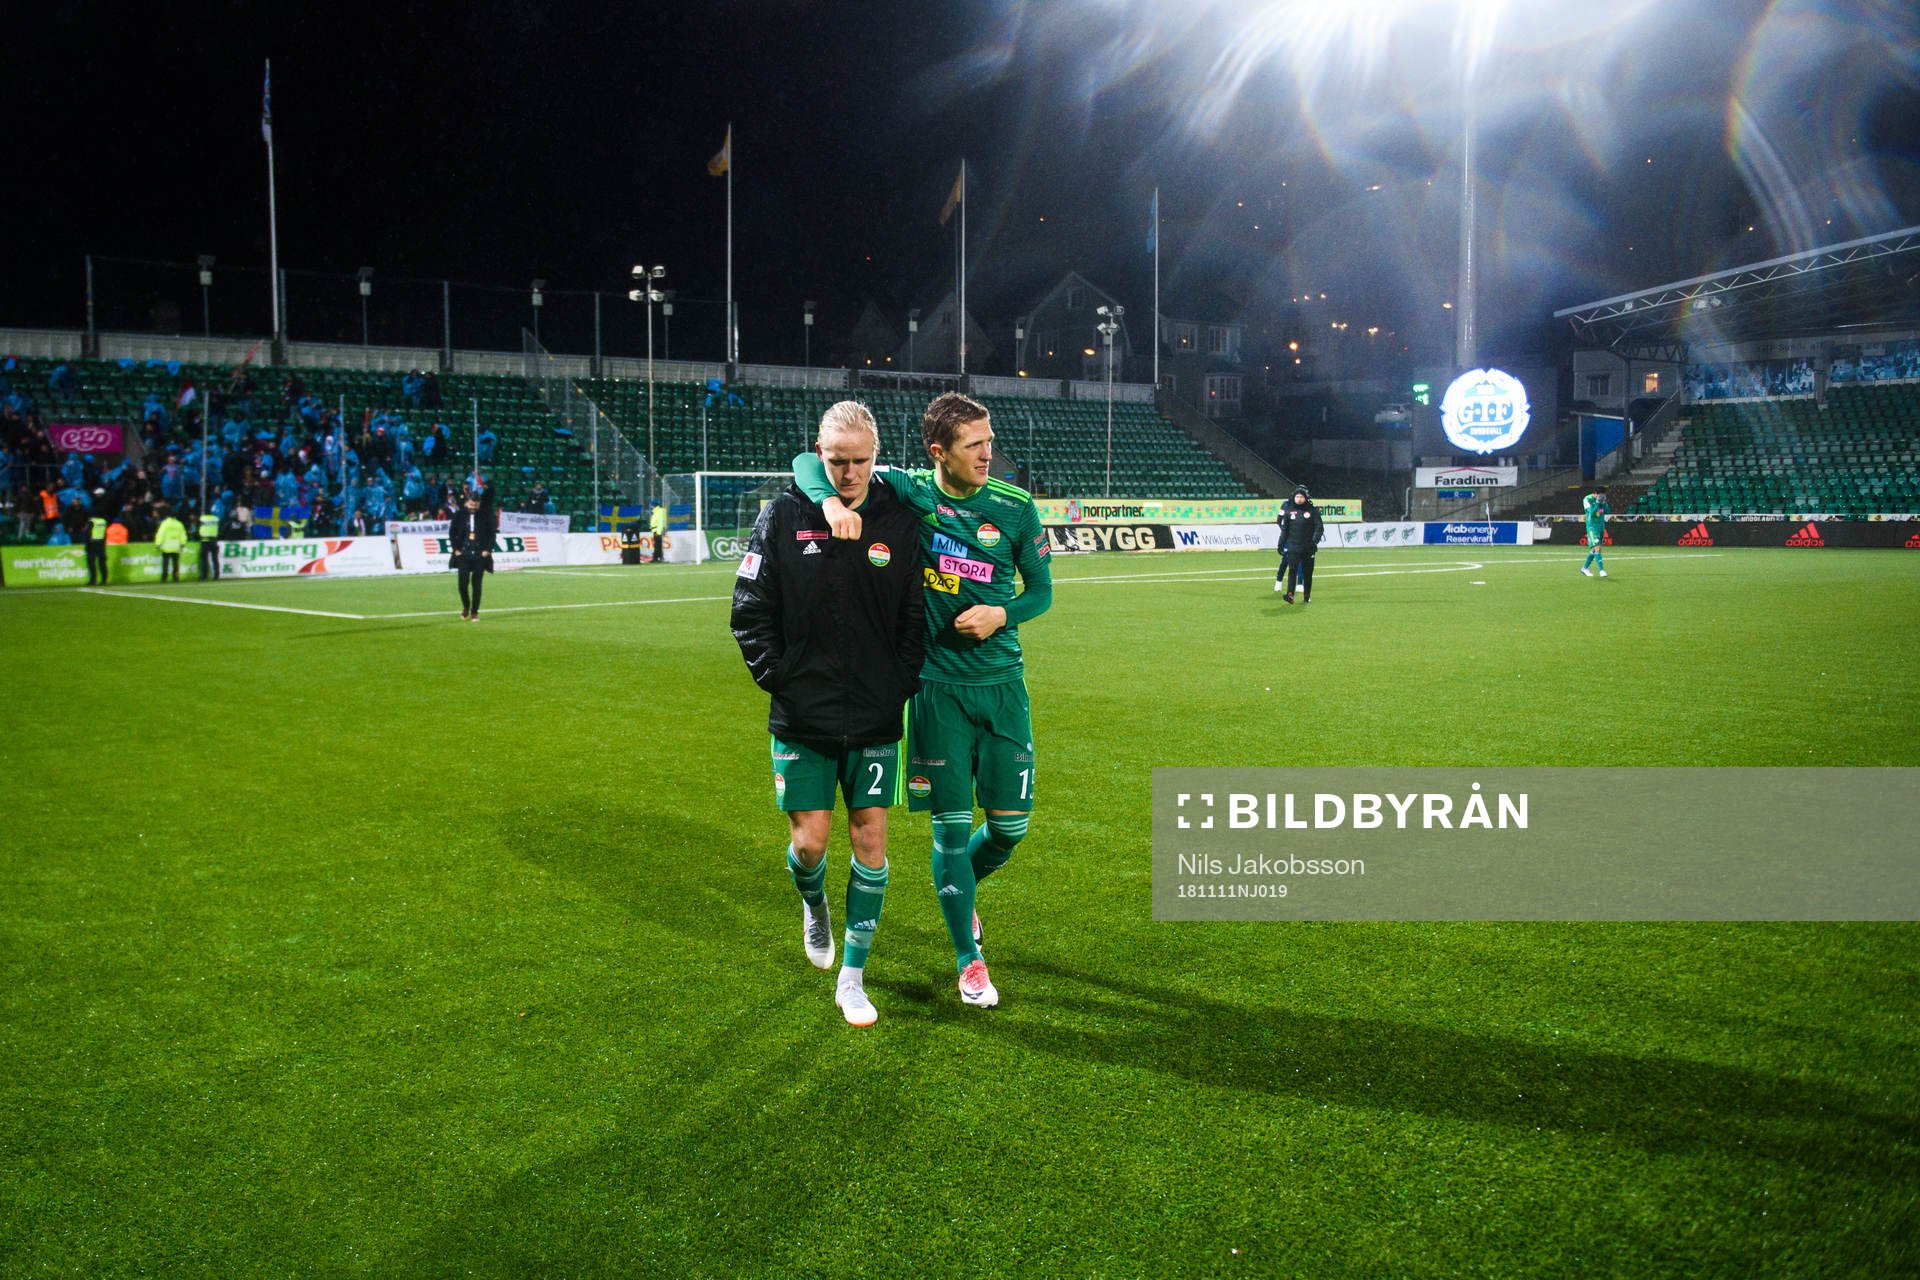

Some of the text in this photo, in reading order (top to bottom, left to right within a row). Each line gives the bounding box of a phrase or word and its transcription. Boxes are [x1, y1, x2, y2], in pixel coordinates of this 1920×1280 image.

[61, 427, 112, 451] ego
[1435, 475, 1498, 486] Faradium
[938, 538, 963, 553] MIN
[1075, 526, 1156, 551] BYGG
[1202, 534, 1243, 545] Wiklunds
[1678, 538, 1713, 546] adidas
[1785, 538, 1825, 547] adidas
[224, 541, 318, 561] Byberg
[222, 562, 296, 573] & Nordin
[944, 559, 987, 578] STORA
[928, 572, 955, 590] DAG
[868, 763, 884, 795] 2
